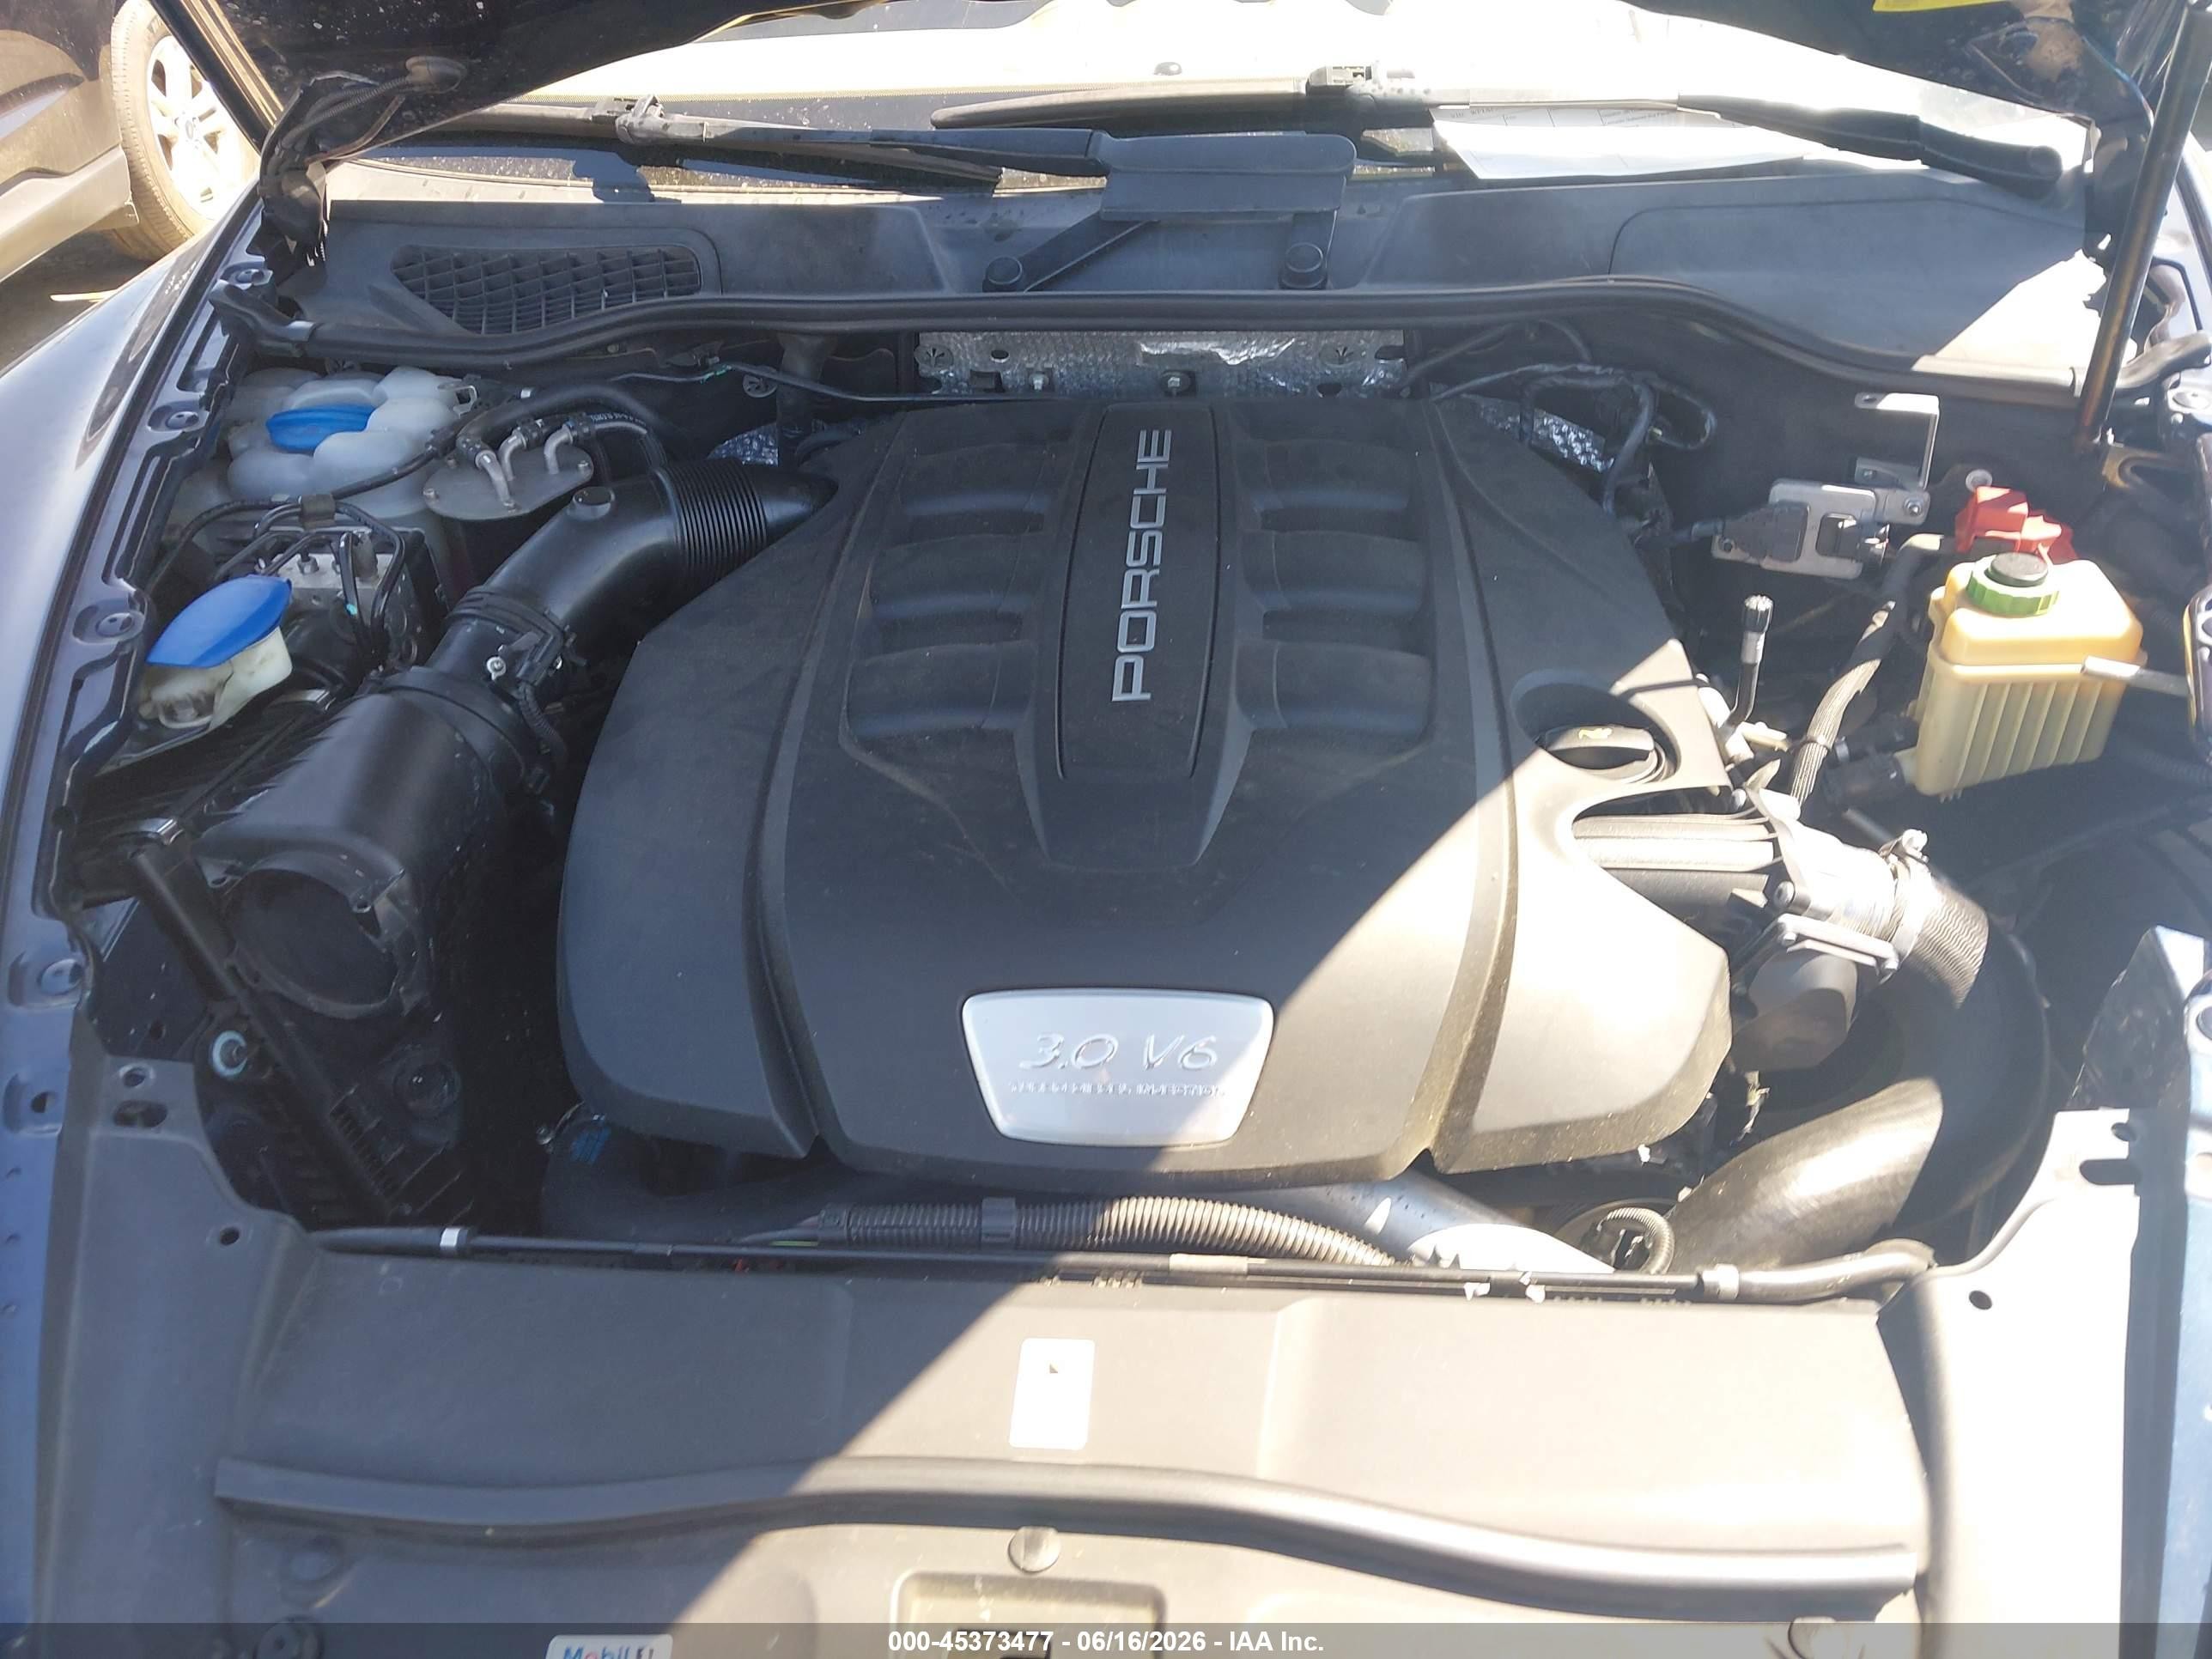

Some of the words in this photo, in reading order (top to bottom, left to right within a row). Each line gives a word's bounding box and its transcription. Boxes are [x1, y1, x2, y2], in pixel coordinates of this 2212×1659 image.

[1112, 429, 1172, 702] PORSCHE
[1018, 1032, 1119, 1070] 3.0
[1142, 1033, 1218, 1071] V6
